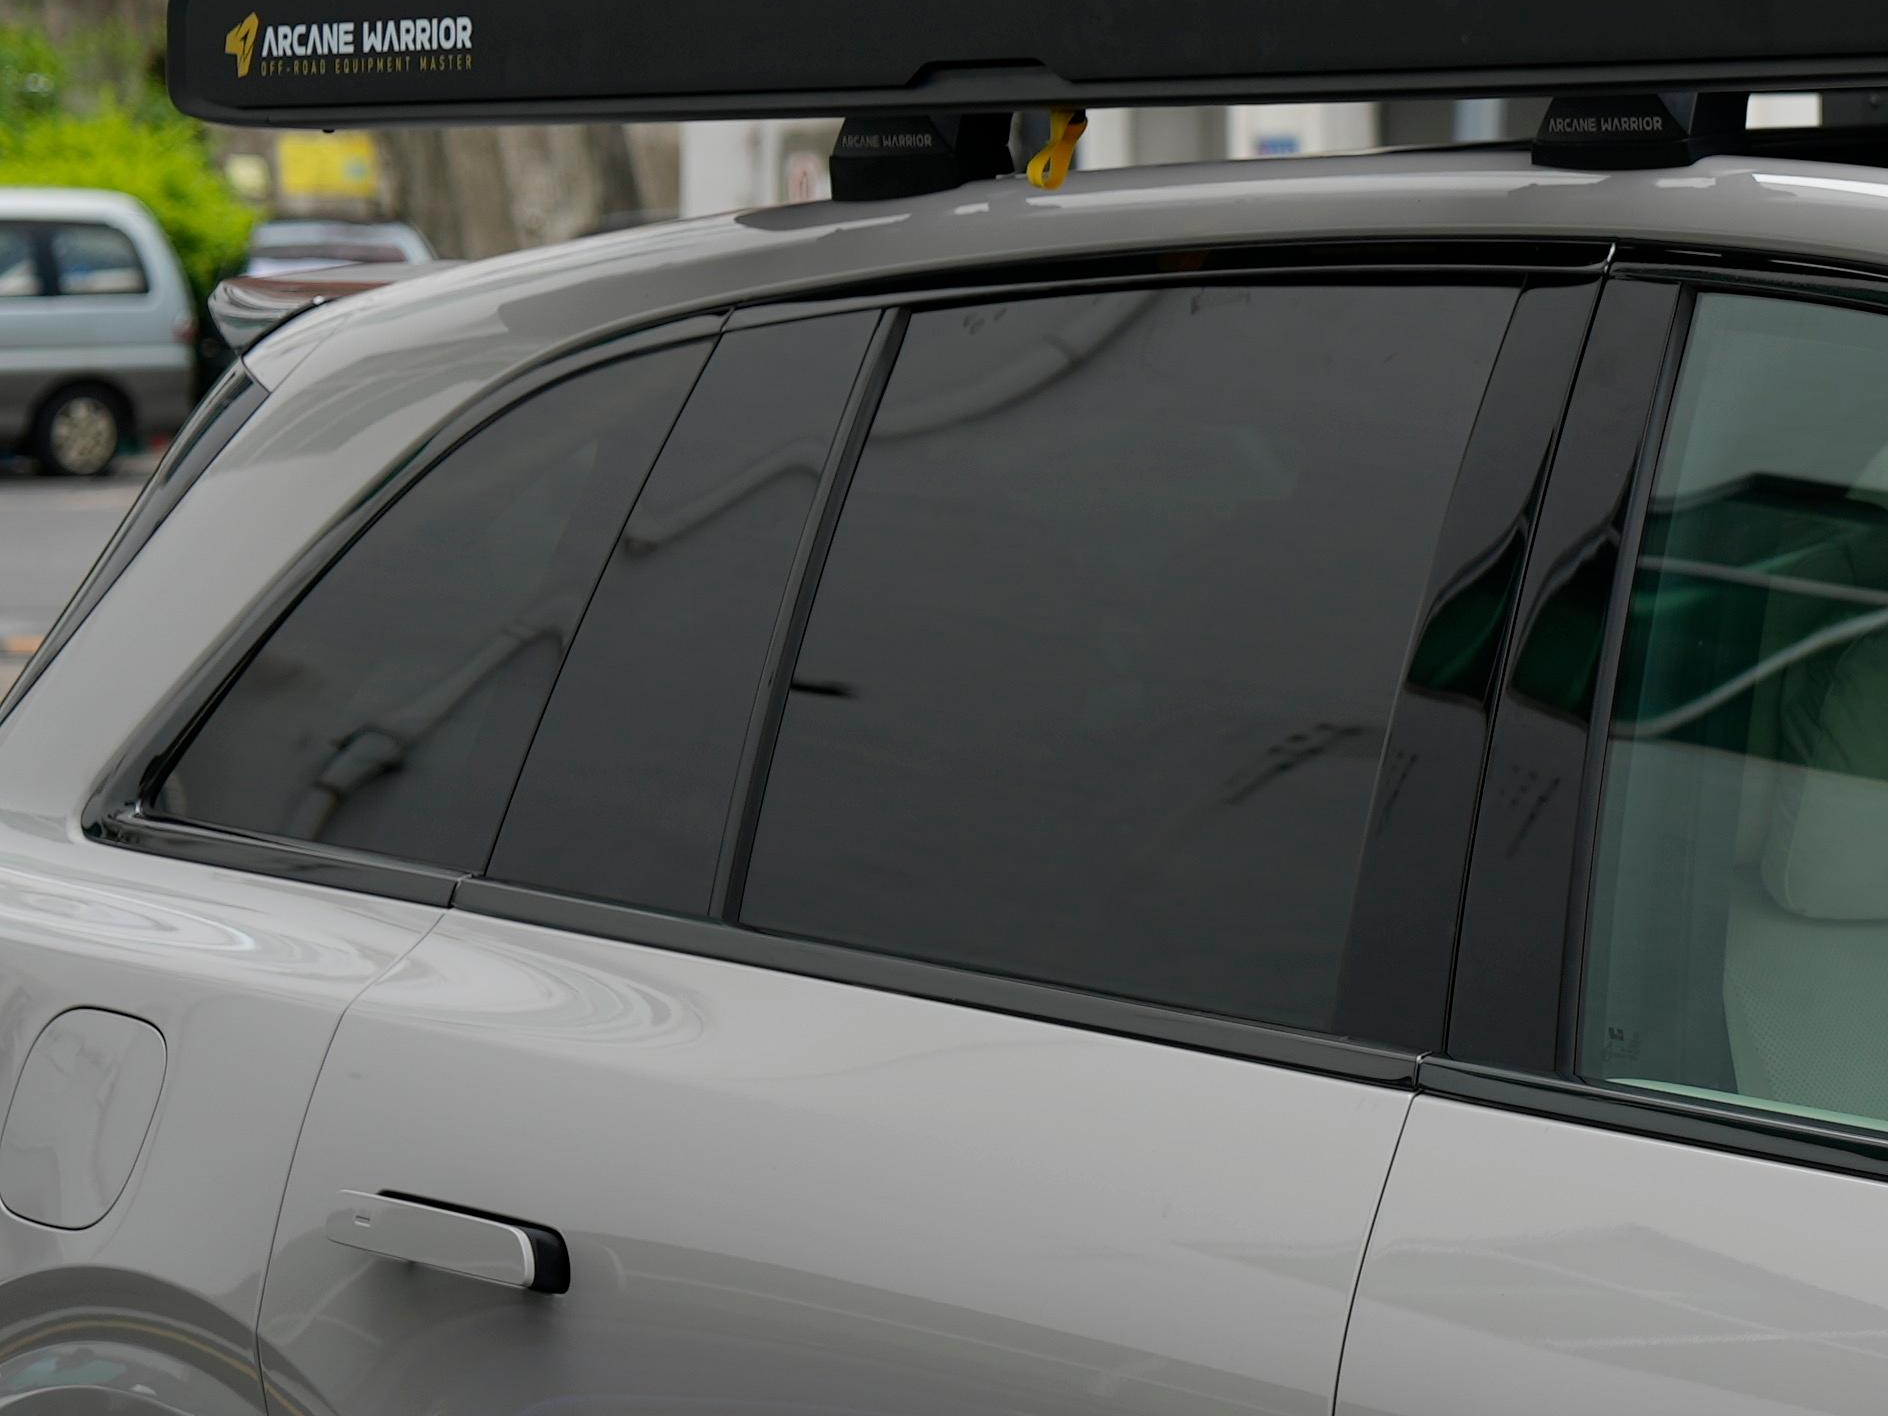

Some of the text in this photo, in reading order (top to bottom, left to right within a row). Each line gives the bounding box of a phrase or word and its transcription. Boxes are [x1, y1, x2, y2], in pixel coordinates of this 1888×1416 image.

[261, 16, 473, 58] ARCANE WARRIOR
[260, 54, 473, 77] OFF-ROAD EQUIPMENT MASTER
[1549, 116, 1662, 133] ARCANE WARRIOR
[842, 134, 932, 148] ARCANE WARRIOR
